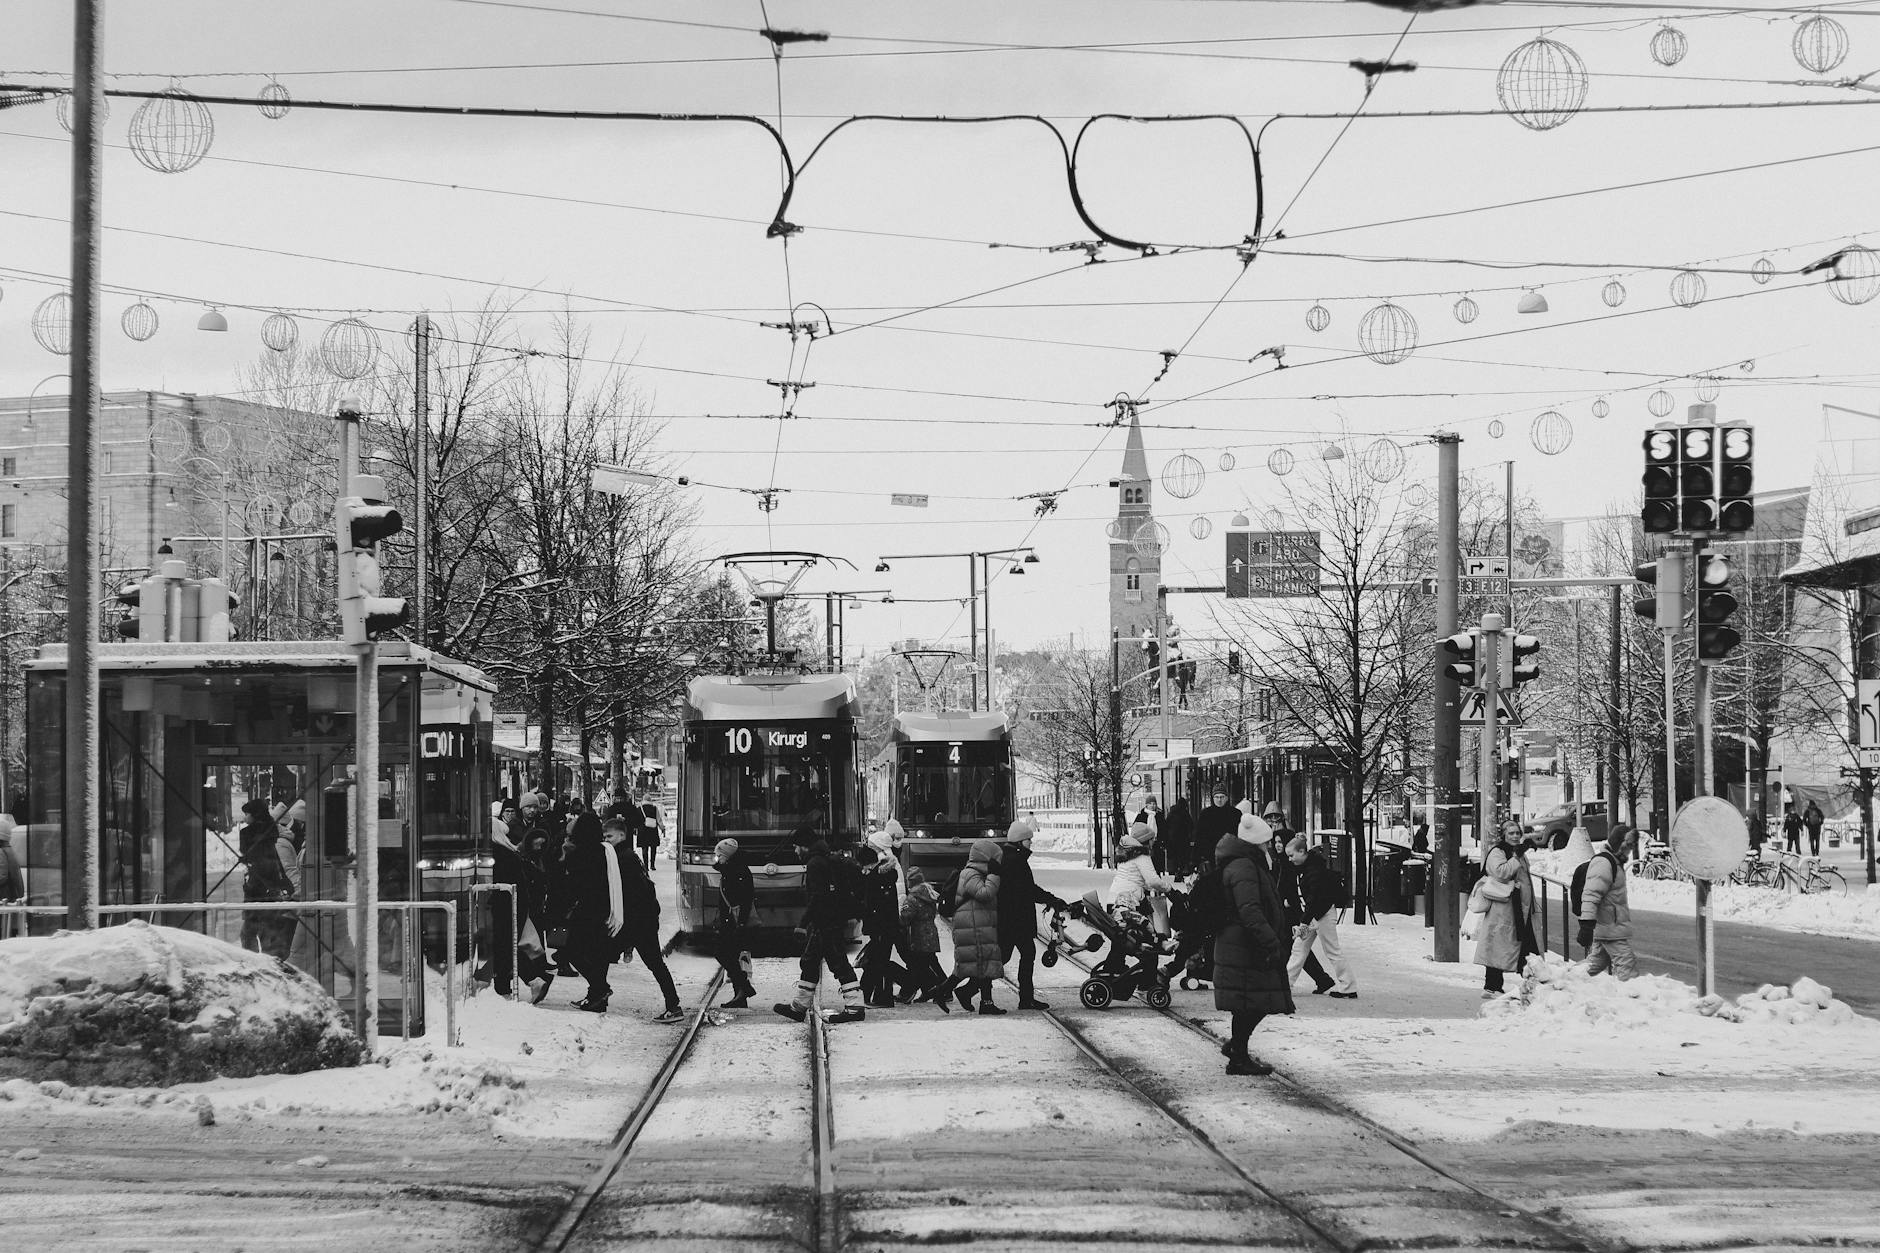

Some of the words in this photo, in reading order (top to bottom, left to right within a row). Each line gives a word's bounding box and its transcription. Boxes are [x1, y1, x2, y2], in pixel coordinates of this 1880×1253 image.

[725, 728, 752, 753] 10
[768, 731, 808, 748] Kirurgi
[949, 746, 961, 763] 4
